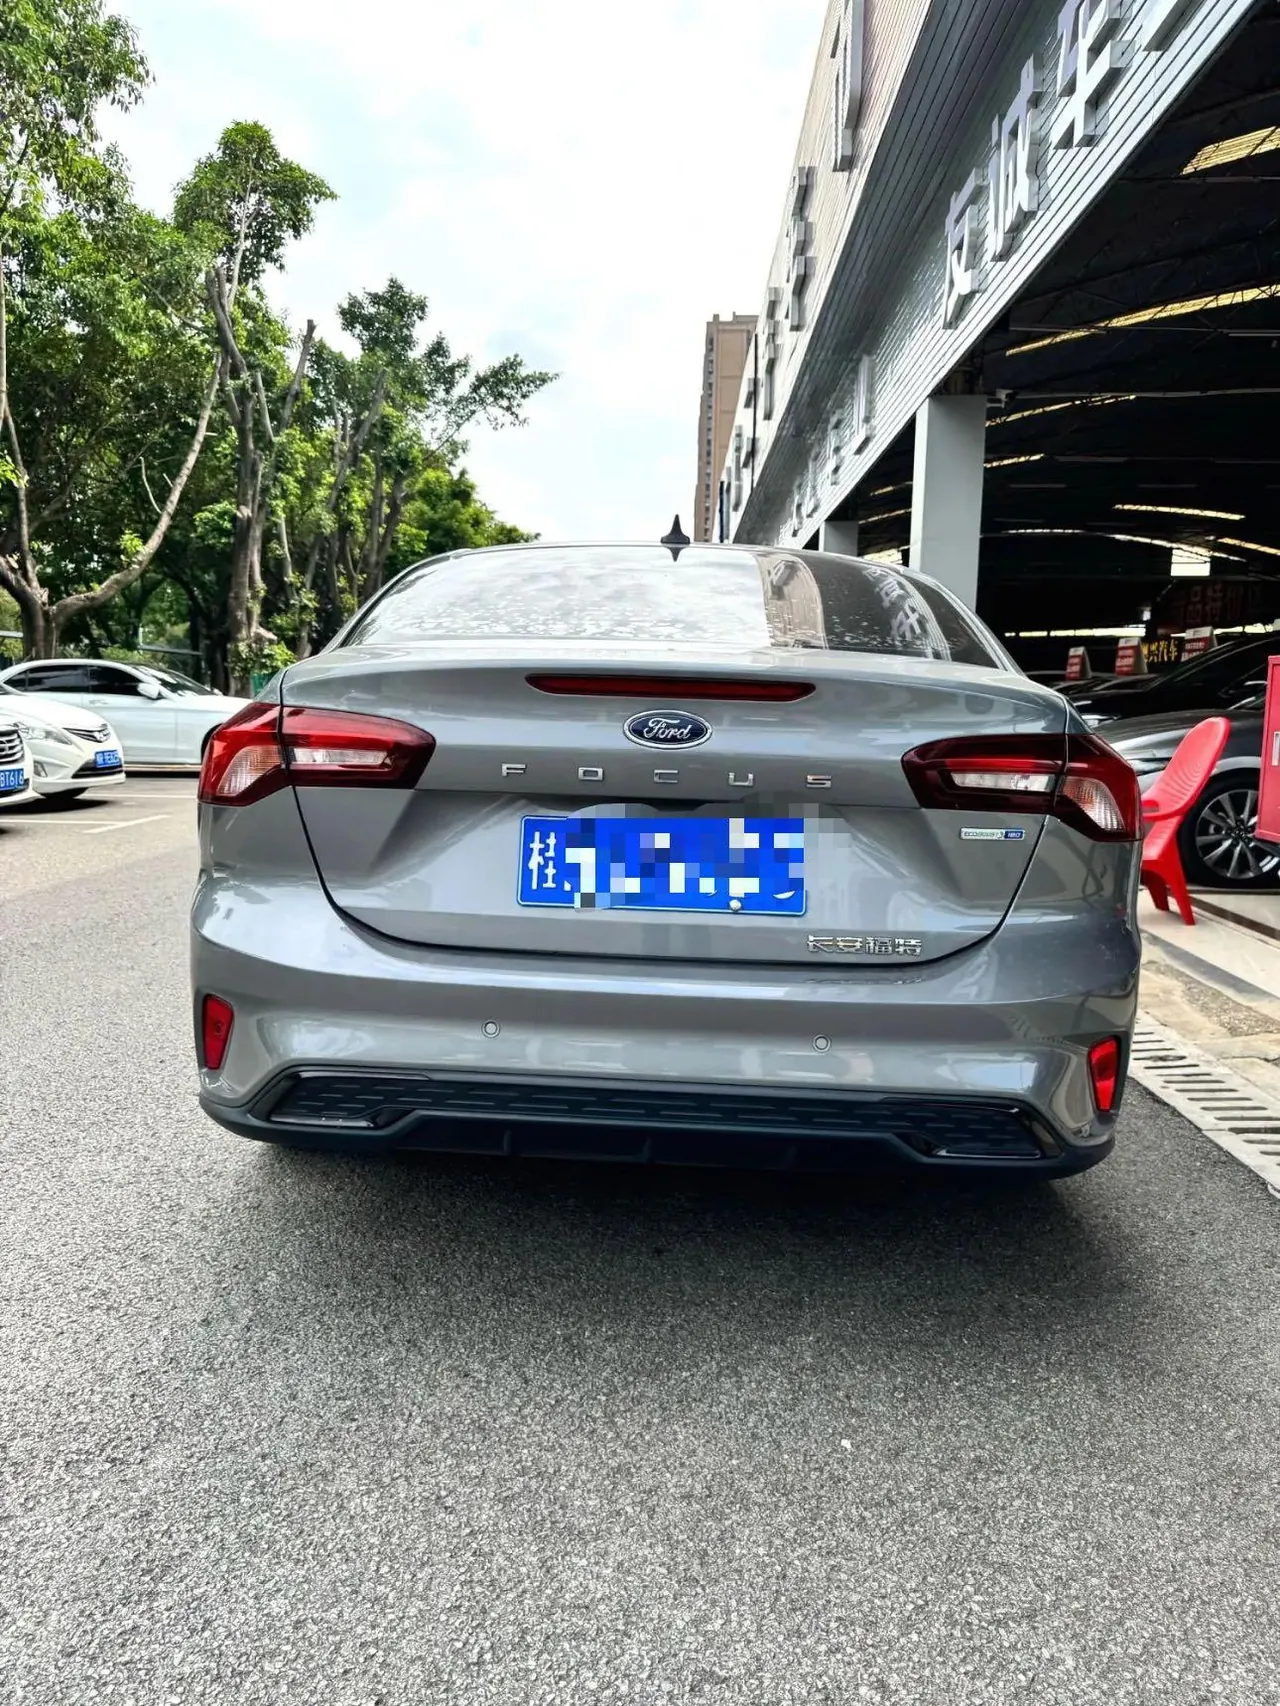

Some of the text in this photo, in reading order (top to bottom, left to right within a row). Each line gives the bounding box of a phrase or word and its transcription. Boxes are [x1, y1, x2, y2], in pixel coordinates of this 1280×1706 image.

[643, 717, 692, 740] Ford
[501, 763, 832, 788] FOCUS
[807, 934, 923, 956] 长安福特
